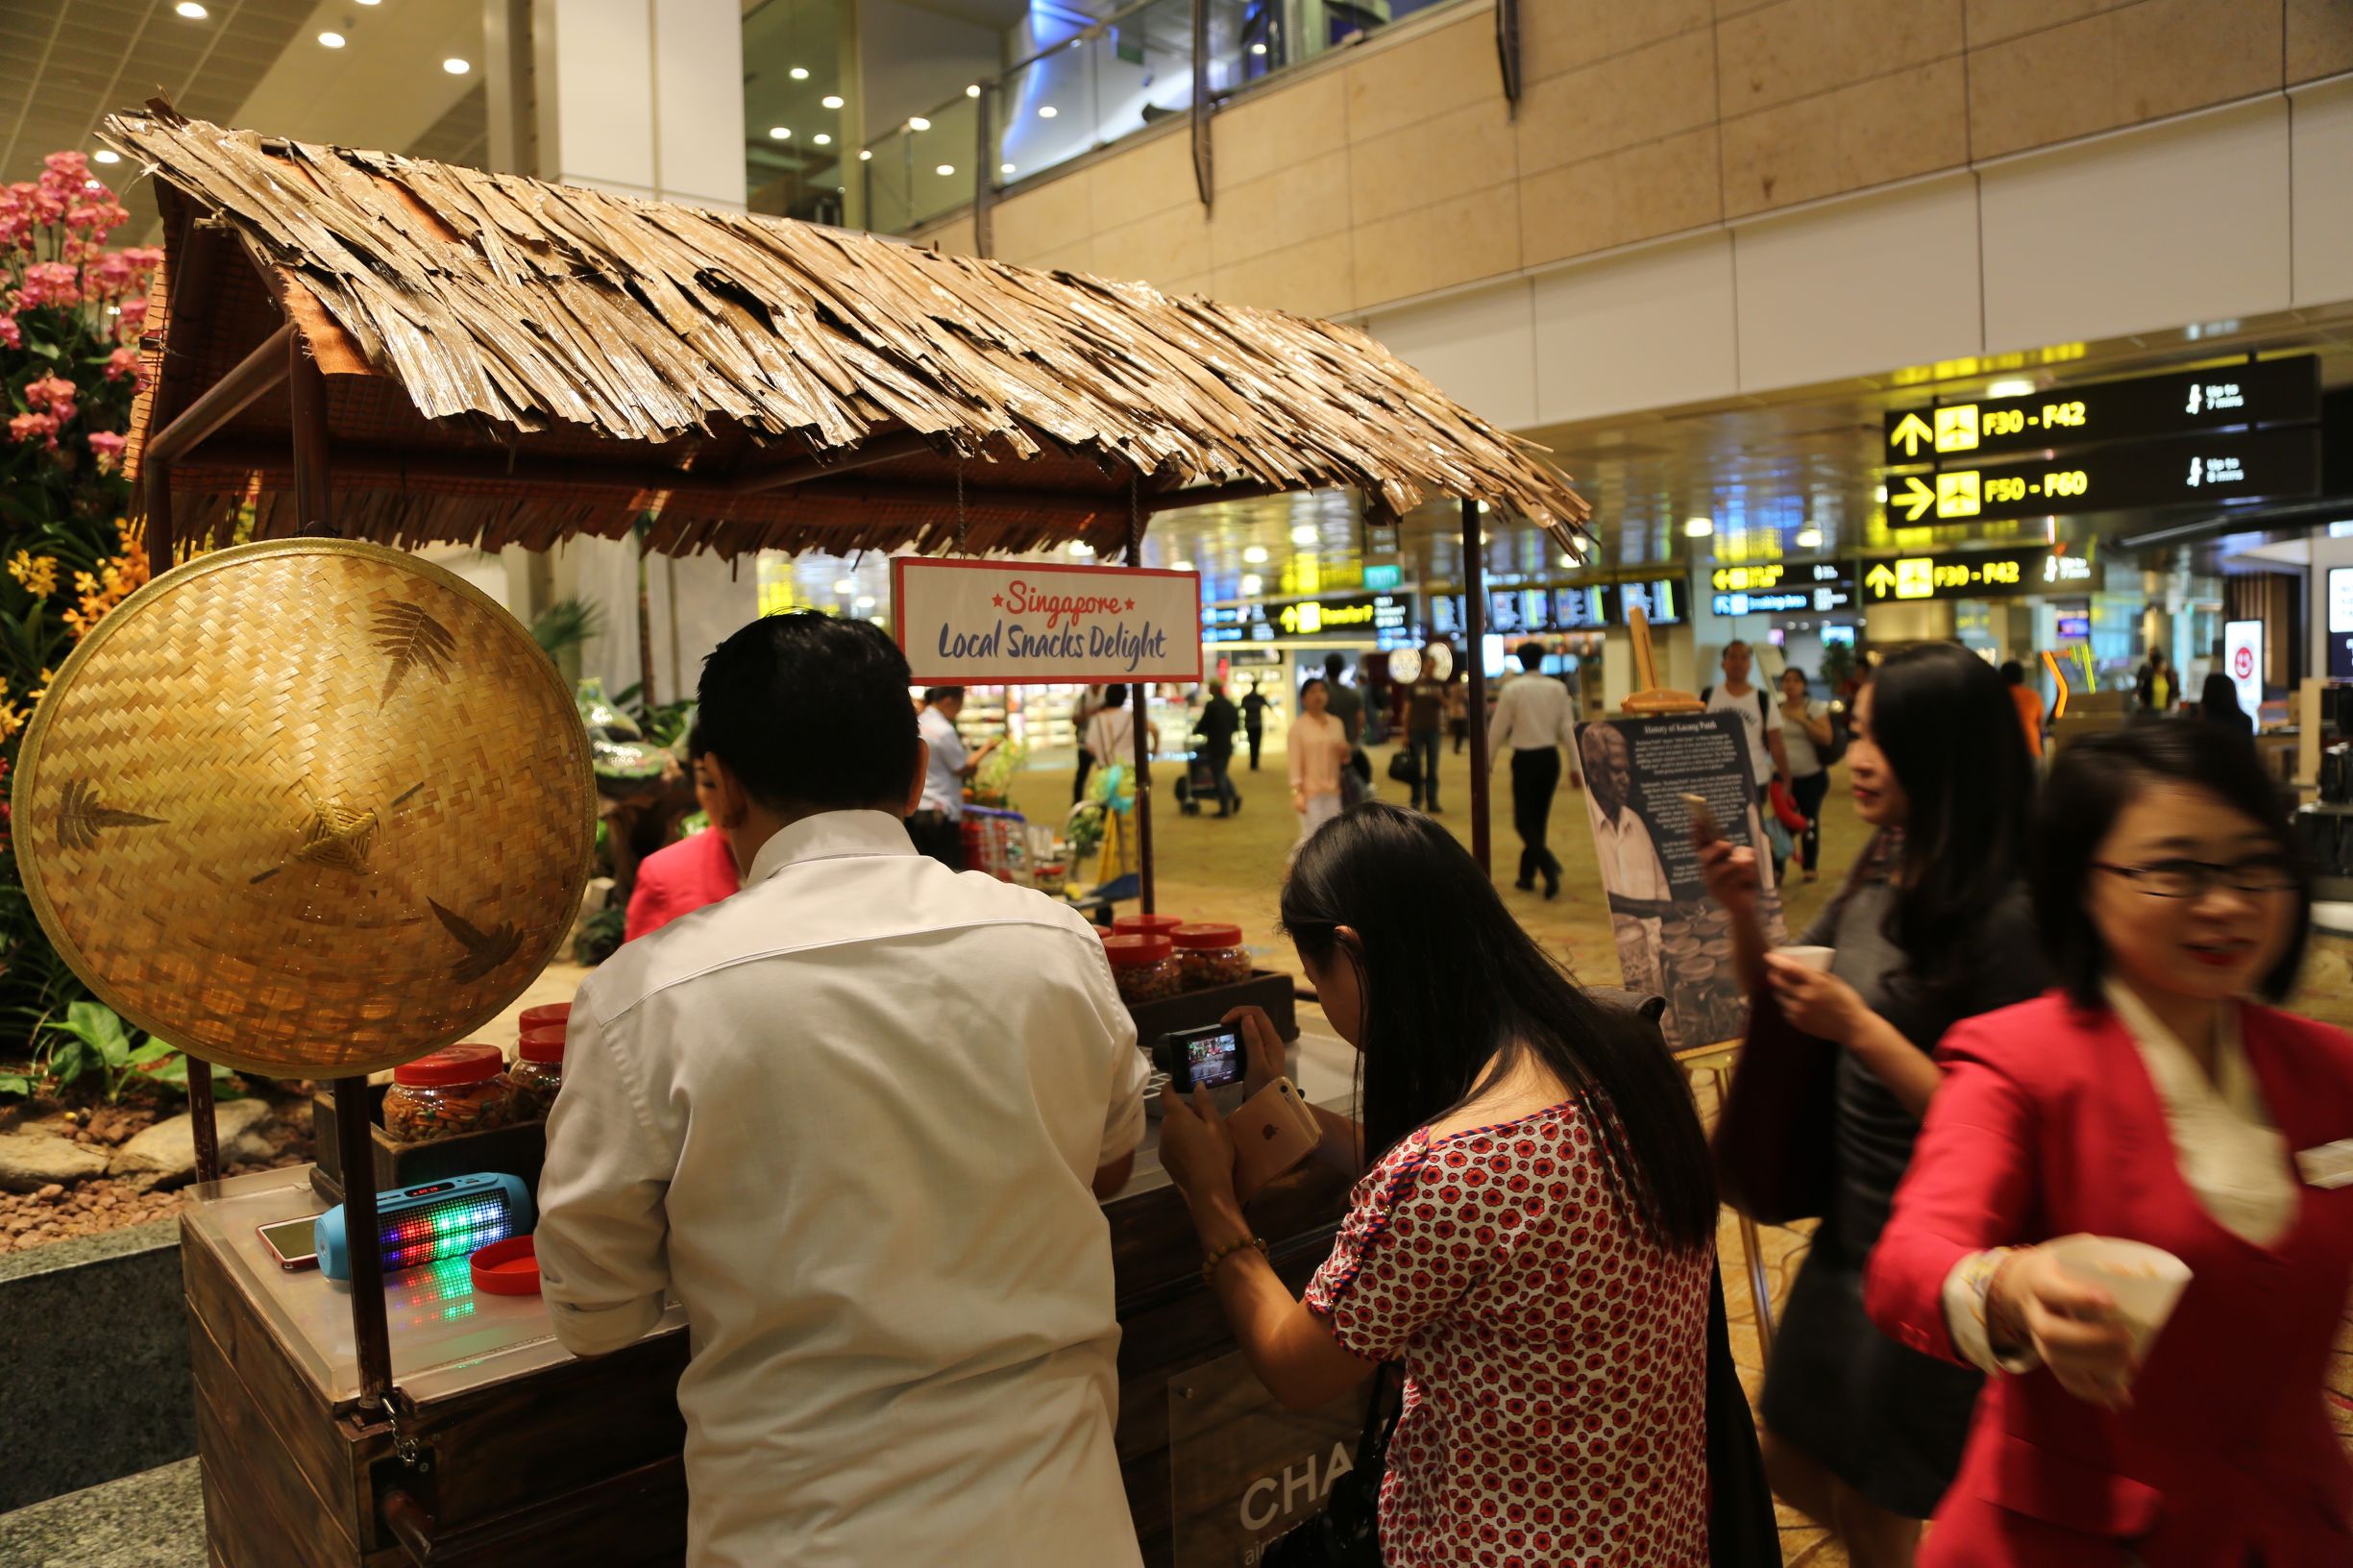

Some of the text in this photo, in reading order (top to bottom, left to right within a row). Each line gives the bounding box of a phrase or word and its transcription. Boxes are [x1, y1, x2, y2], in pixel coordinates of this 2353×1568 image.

[1983, 409, 2024, 436] F30
[2043, 402, 2086, 429] F42
[1984, 477, 2025, 502] F50
[2044, 471, 2088, 498] F60
[1933, 565, 1970, 587] F30
[1982, 561, 2020, 584] F42
[1006, 580, 1122, 629] Singapore
[938, 620, 1002, 658] Local
[1007, 622, 1085, 658] Snacks
[1089, 621, 1166, 672] Delight
